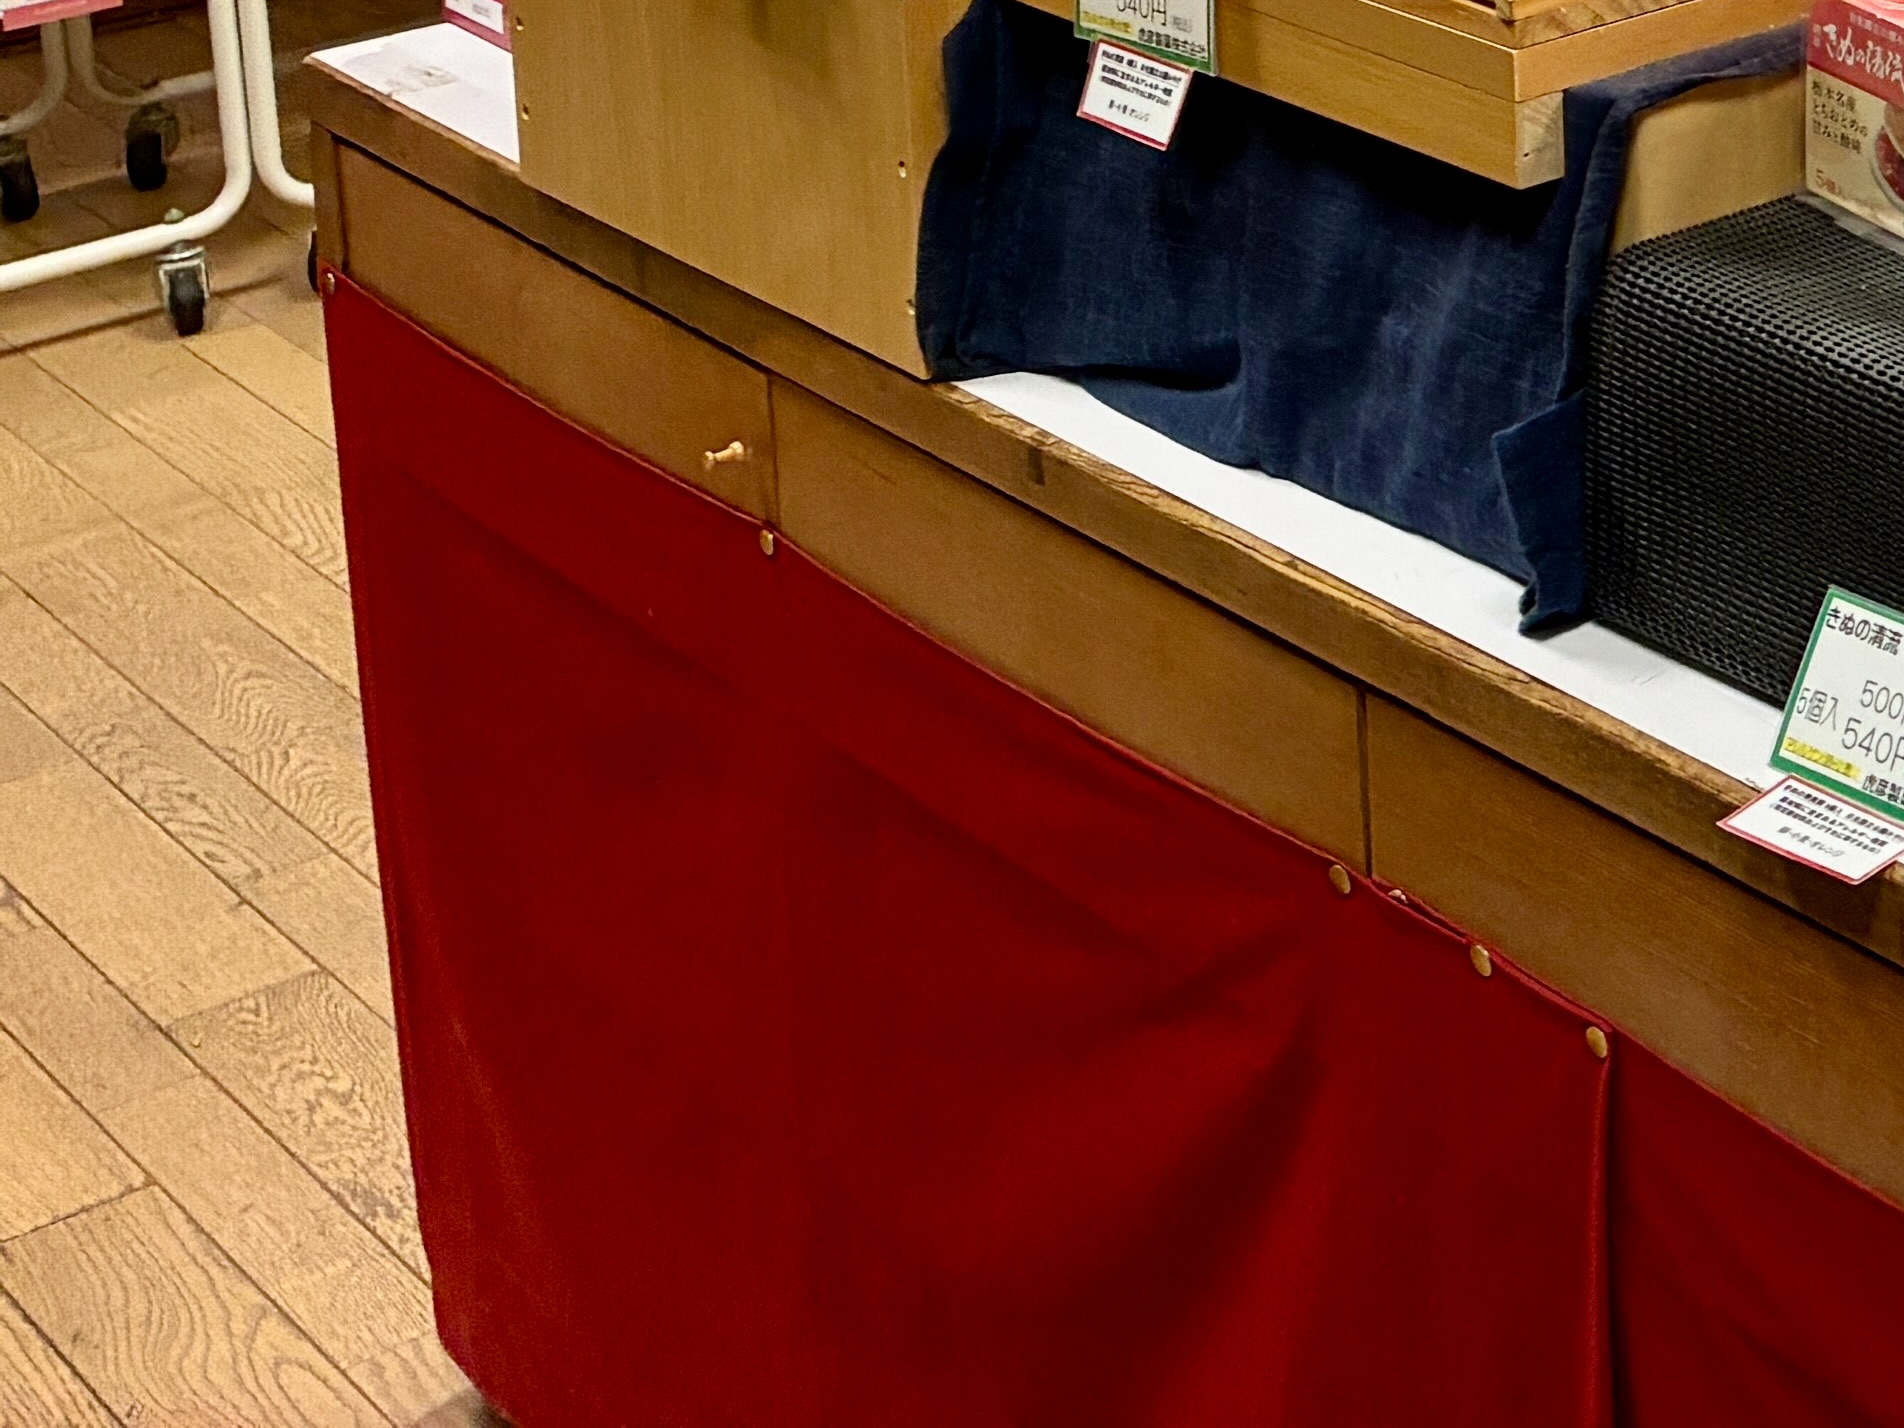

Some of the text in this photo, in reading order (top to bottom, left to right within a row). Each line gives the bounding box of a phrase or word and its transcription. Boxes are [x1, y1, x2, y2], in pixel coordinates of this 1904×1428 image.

[1825, 605, 1904, 656] きぬの清流
[1796, 686, 1839, 732] 5個入
